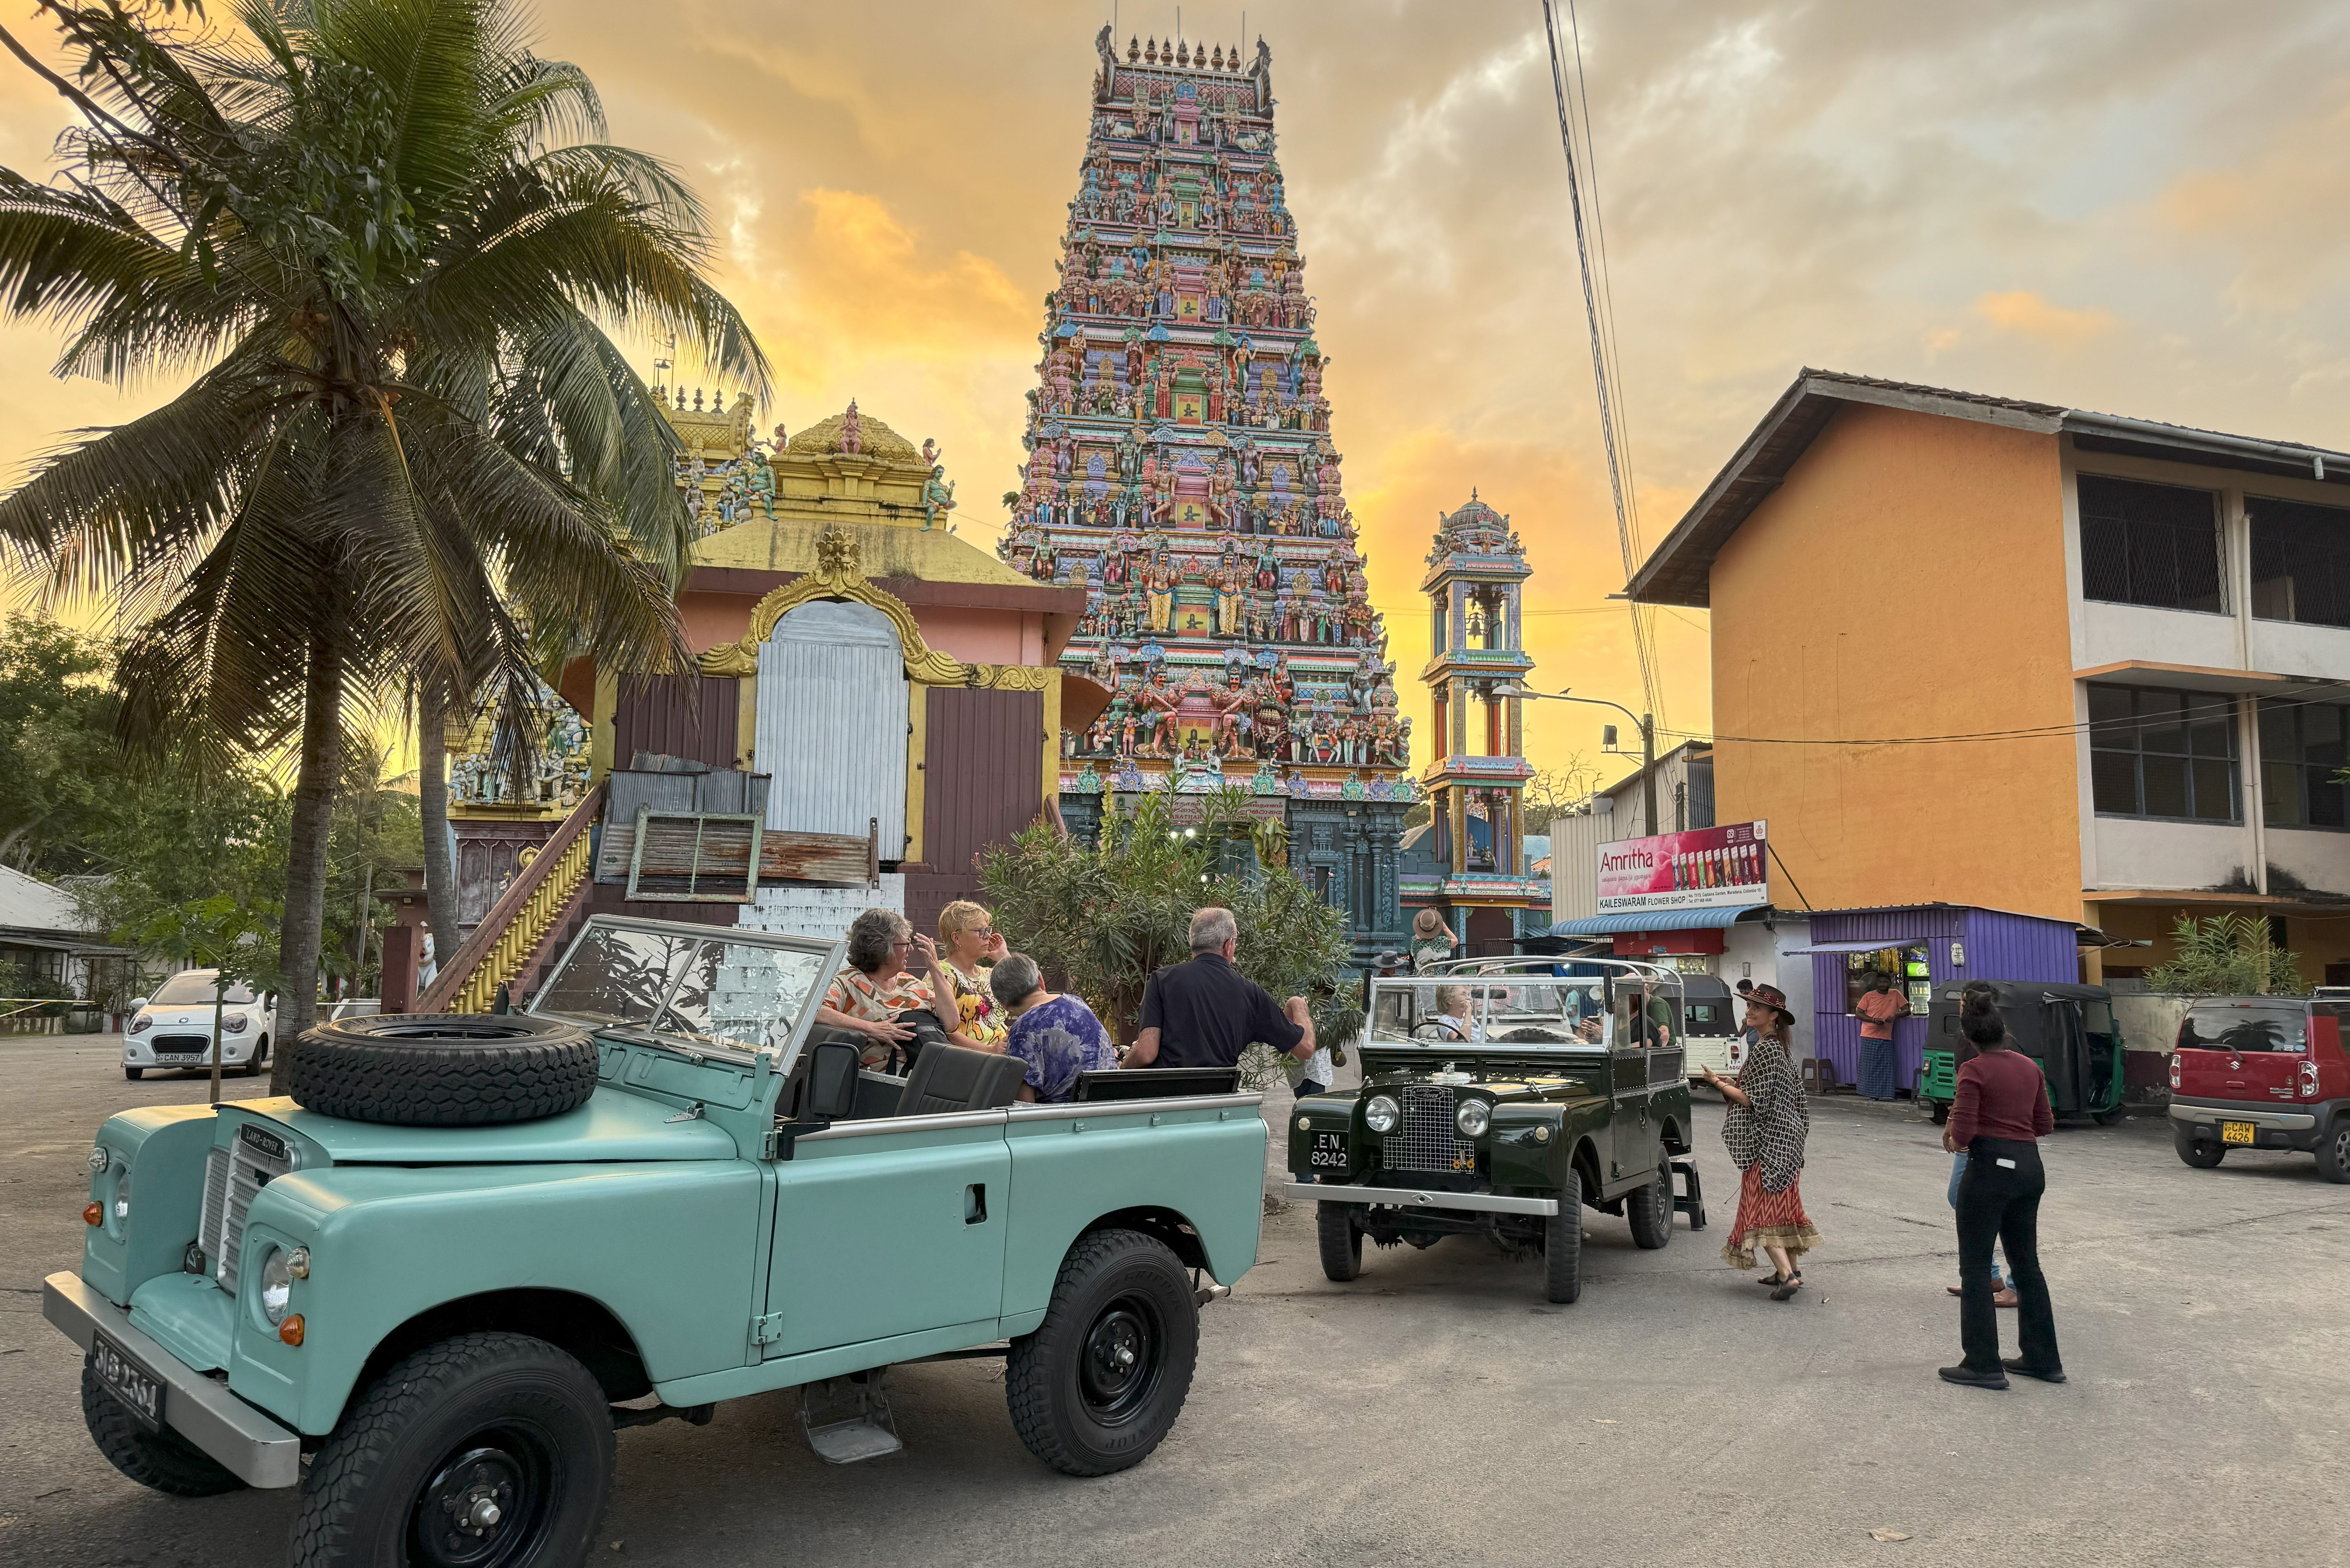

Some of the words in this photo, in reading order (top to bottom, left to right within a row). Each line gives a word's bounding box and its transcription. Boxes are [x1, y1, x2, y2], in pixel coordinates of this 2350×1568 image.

[1600, 848, 1653, 872] Amritha
[1600, 897, 1646, 909] KAILESWARAM
[2232, 1123, 2251, 1133] CAW
[2226, 1132, 2250, 1143] 4426
[1311, 1151, 1347, 1167] 8242
